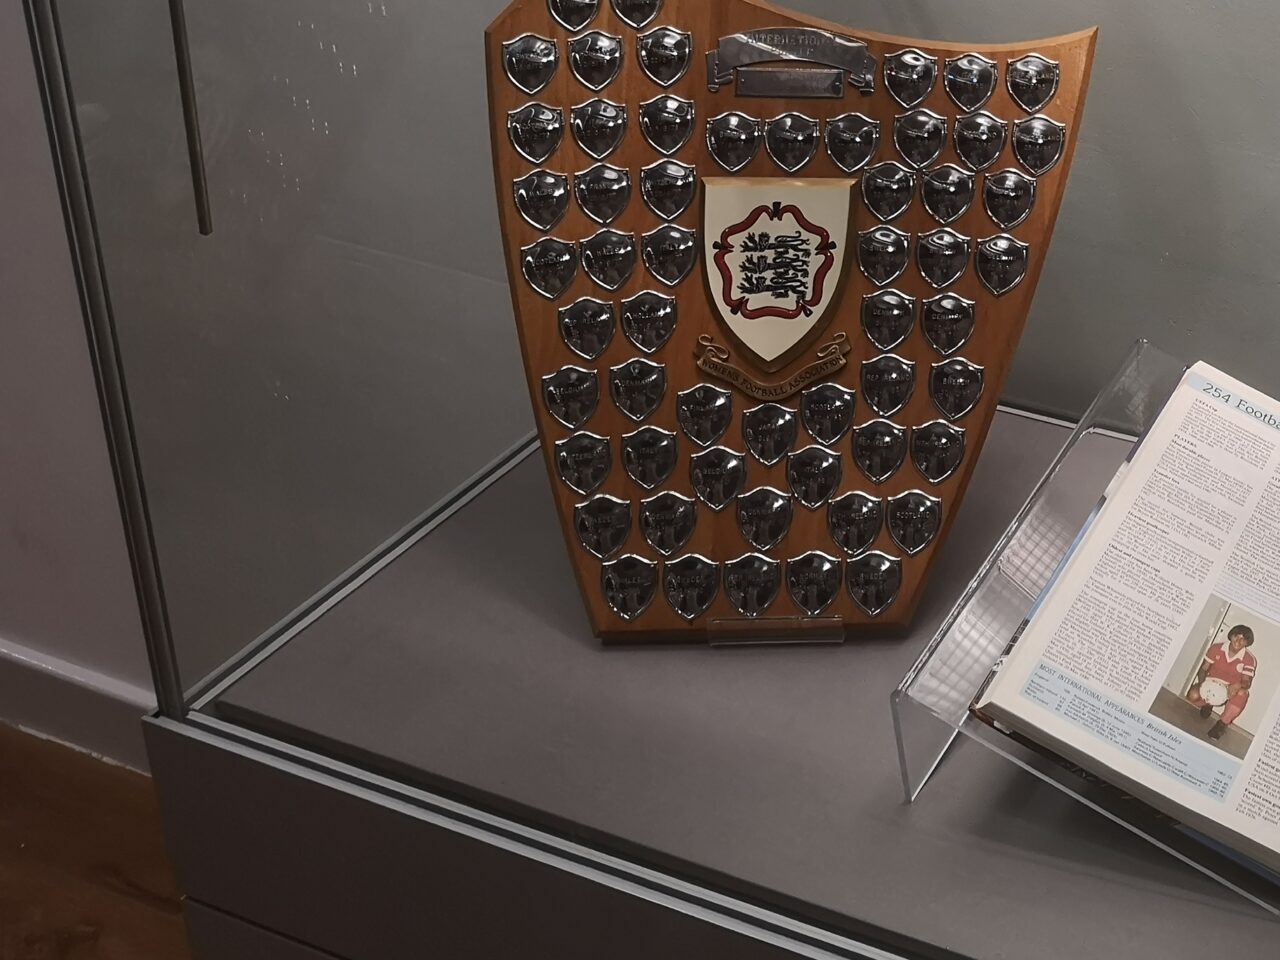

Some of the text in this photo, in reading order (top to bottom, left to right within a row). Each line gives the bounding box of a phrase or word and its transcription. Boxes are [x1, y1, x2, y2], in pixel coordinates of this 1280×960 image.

[741, 376, 786, 397] FOOTBALL
[789, 355, 842, 390] ASSOCIATION
[1202, 382, 1232, 404] 254
[1039, 663, 1056, 677] MOST
[1057, 672, 1102, 701] INTERNATIONAL
[1104, 699, 1146, 726] APPEARANCES
[1146, 722, 1167, 738] British
